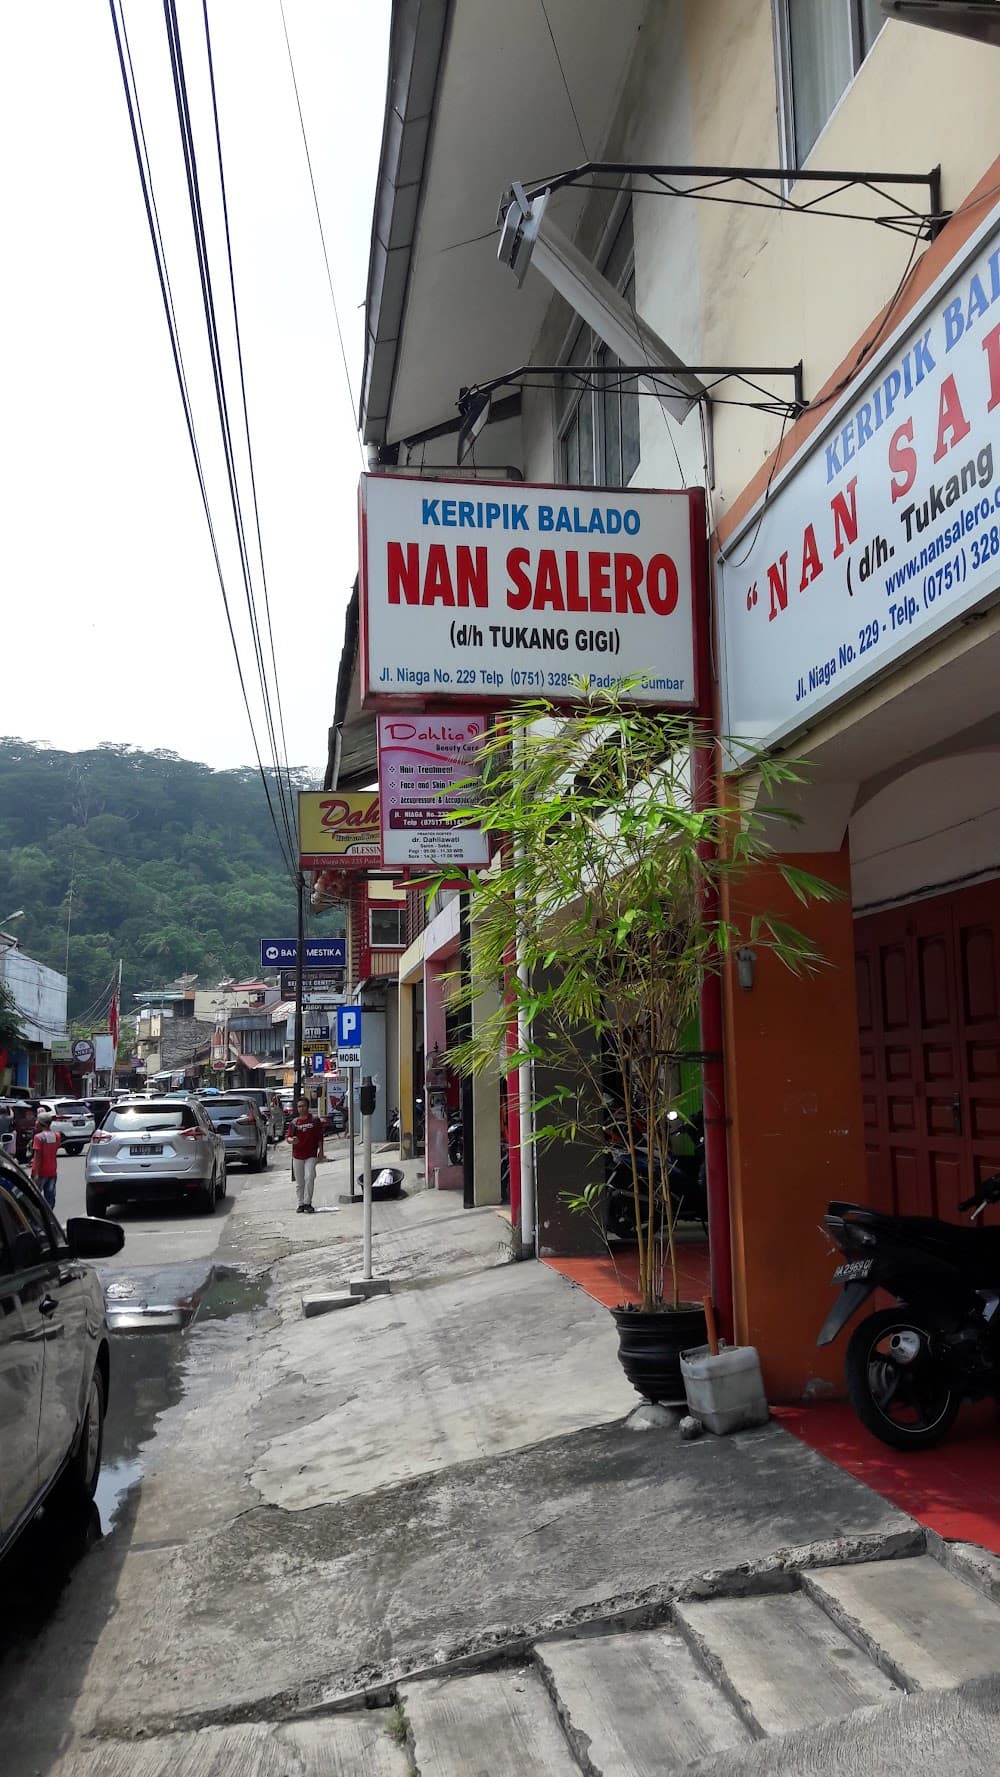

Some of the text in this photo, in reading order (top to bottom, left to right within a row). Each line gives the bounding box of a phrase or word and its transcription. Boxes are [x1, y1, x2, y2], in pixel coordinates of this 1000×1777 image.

[825, 327, 936, 486] KERIPIK
[900, 443, 994, 543] Tukang
[421, 498, 641, 535] KERIPIK BALADO
[387, 541, 679, 616] NAN SALERO
[795, 677, 807, 701] Jl.
[808, 658, 836, 692] Niaga
[838, 643, 857, 669] No.
[858, 619, 879, 655] 229
[889, 595, 919, 630] Telp.
[923, 547, 967, 609] (0751)
[970, 525, 1000, 570] 328
[449, 620, 621, 655] (d/h TUKANG GIGI)
[379, 667, 393, 682] Jl.
[396, 667, 430, 686] Niaga
[433, 668, 453, 684] No.
[456, 669, 476, 684] 229
[479, 670, 504, 688] Telp
[510, 668, 545, 687] (0751)
[384, 723, 465, 741] Dahlia
[399, 765, 453, 774] Hair Treatment
[400, 780, 415, 789] Face
[418, 780, 430, 789] and
[432, 780, 446, 789] Skin
[280, 948, 298, 957] BAN
[306, 948, 342, 957] MESTIKA
[342, 1012, 357, 1040] P
[315, 1055, 323, 1070] P
[339, 1053, 360, 1062] MOBIL
